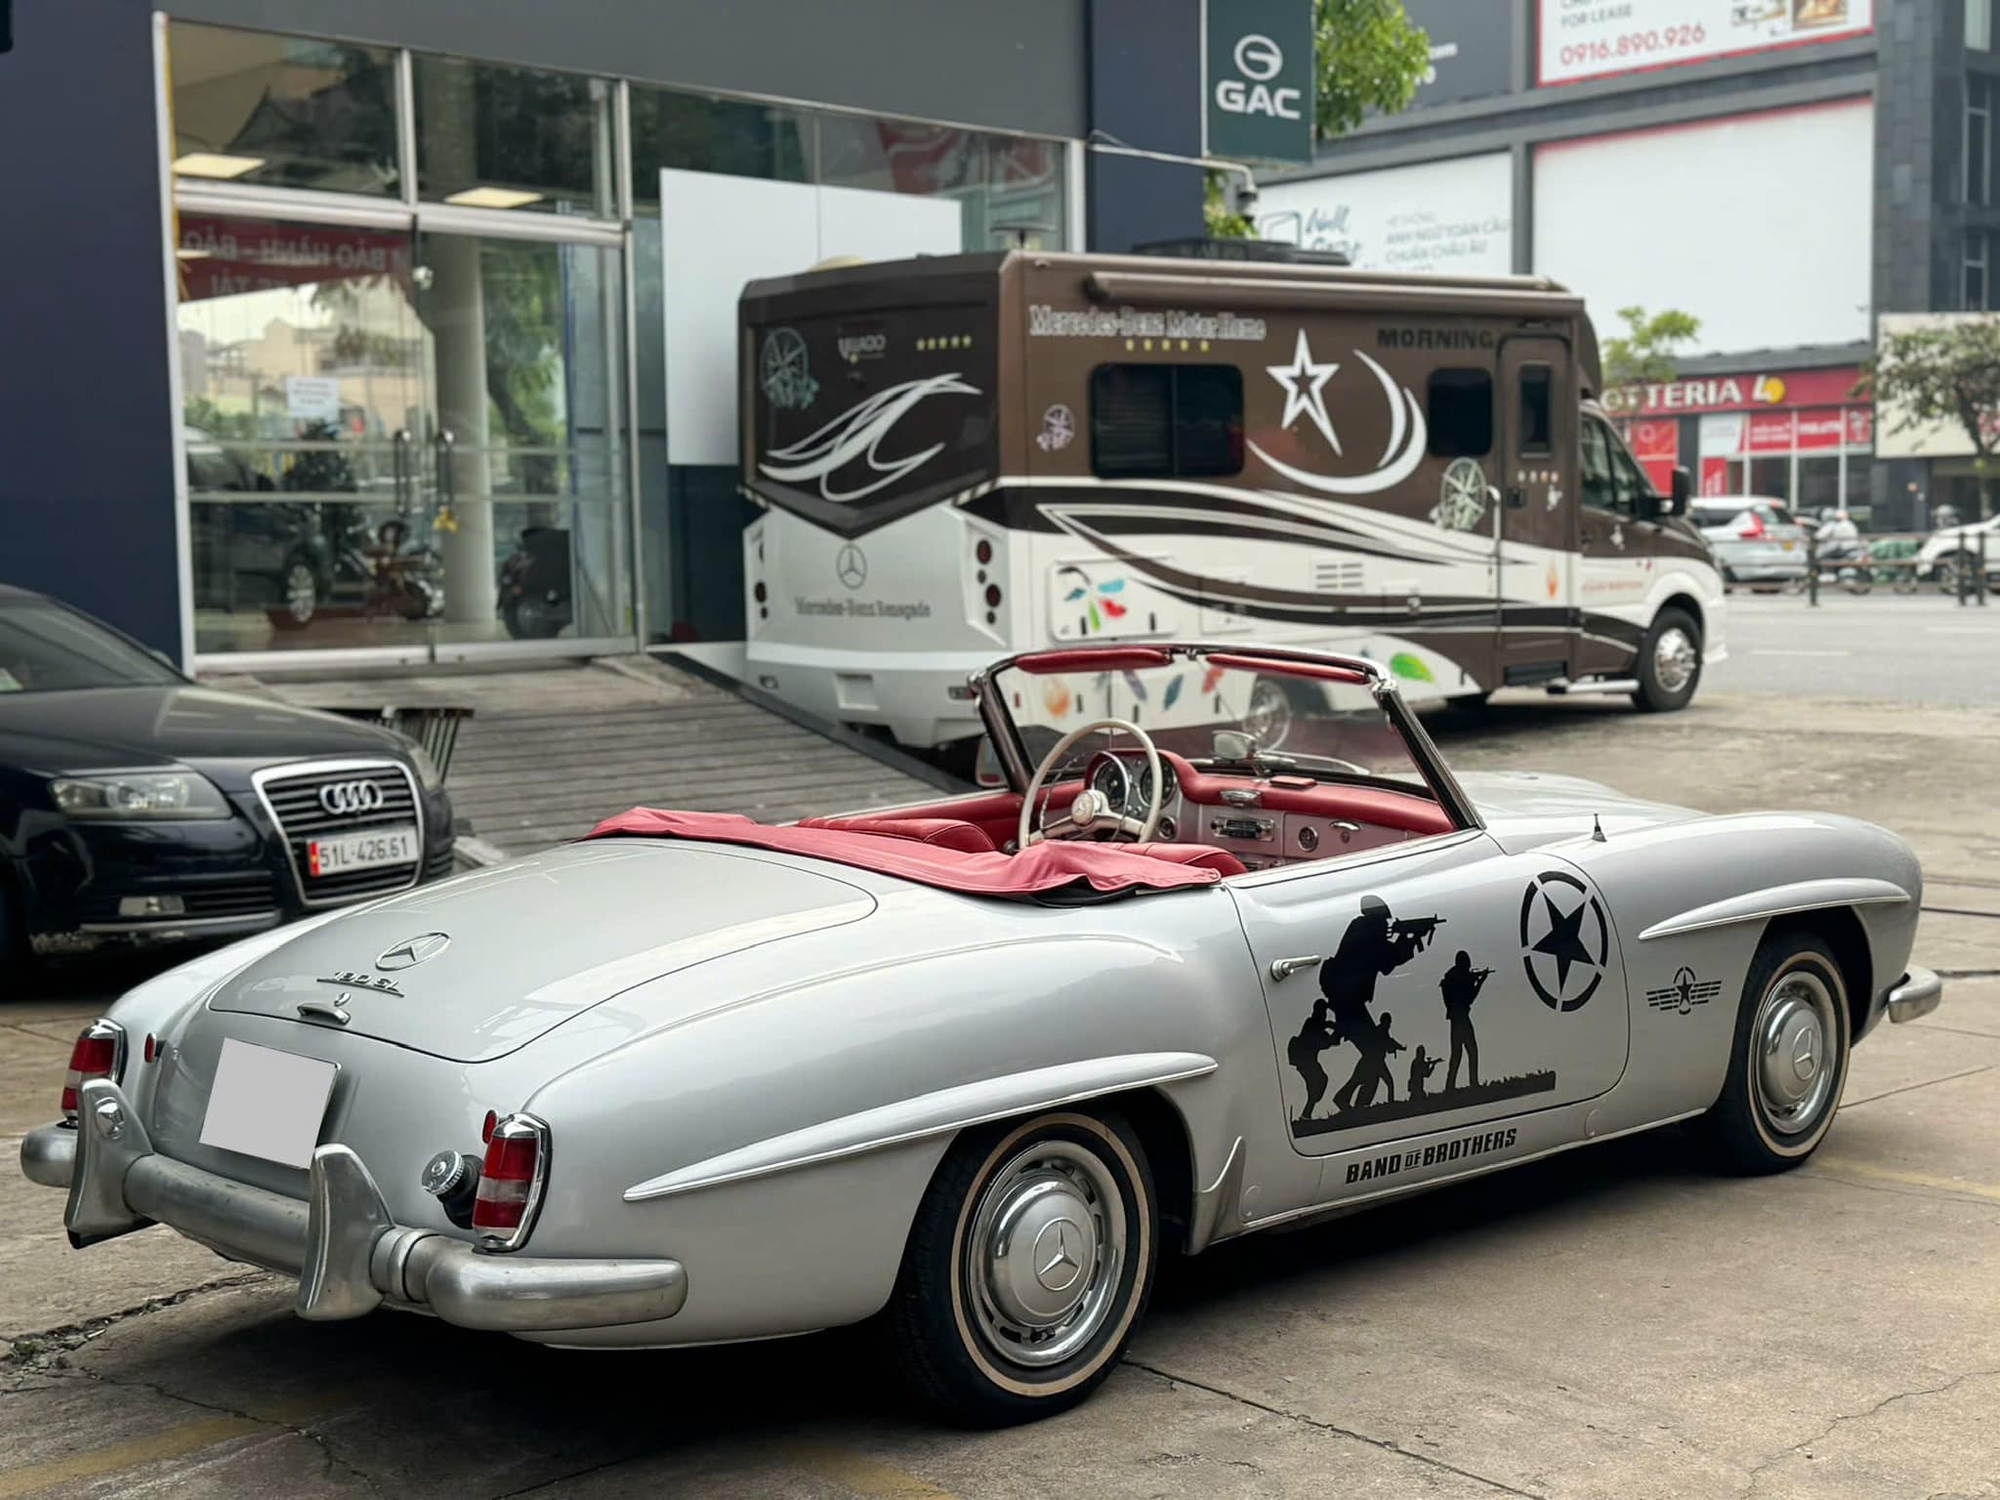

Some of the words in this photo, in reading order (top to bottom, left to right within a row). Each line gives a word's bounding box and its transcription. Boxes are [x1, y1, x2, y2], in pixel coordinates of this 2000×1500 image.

[1590, 3, 1633, 23] LEASE
[1560, 24, 1706, 66] 0916.890.926
[1215, 79, 1301, 120] GAC
[1377, 328, 1494, 349] MORNING
[1600, 379, 1742, 411] OTTERIA
[1345, 1154, 1402, 1184] BAND
[1404, 1150, 1422, 1170] OF
[1422, 1128, 1517, 1166] BROTHERS
